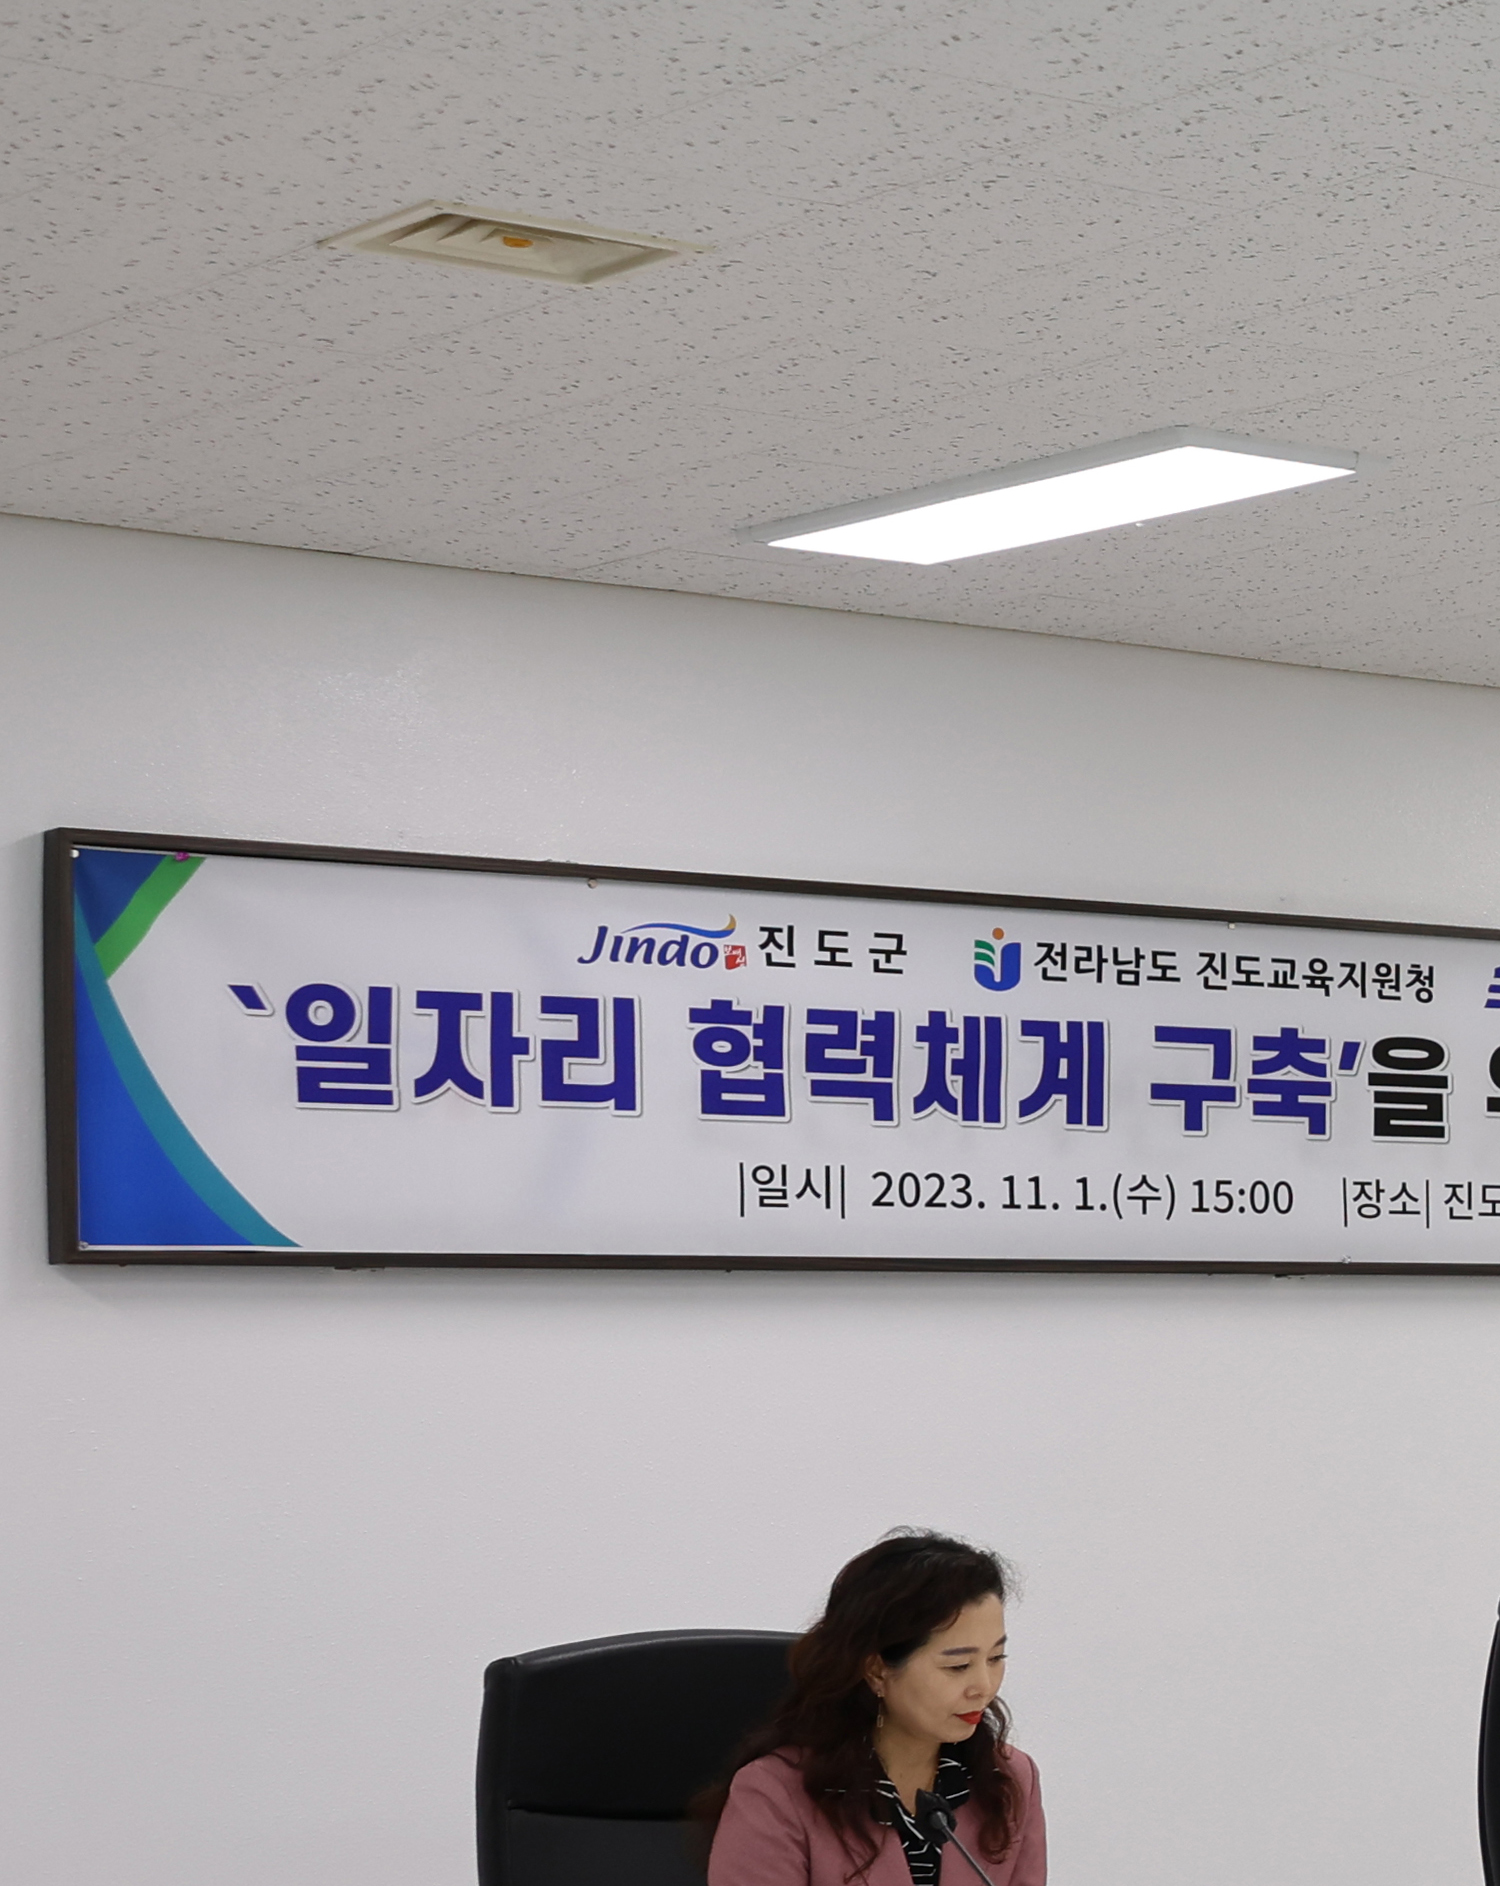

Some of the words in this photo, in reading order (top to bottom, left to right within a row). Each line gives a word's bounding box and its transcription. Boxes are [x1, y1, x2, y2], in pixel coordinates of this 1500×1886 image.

[577, 924, 719, 969] Jindo
[1034, 943, 1180, 986] 전라남도
[1197, 952, 1433, 1003] 진도교육지원청
[689, 990, 1109, 1132] 협력체계
[872, 1172, 985, 1209] 2023.
[1192, 1180, 1293, 1214] 15:00
